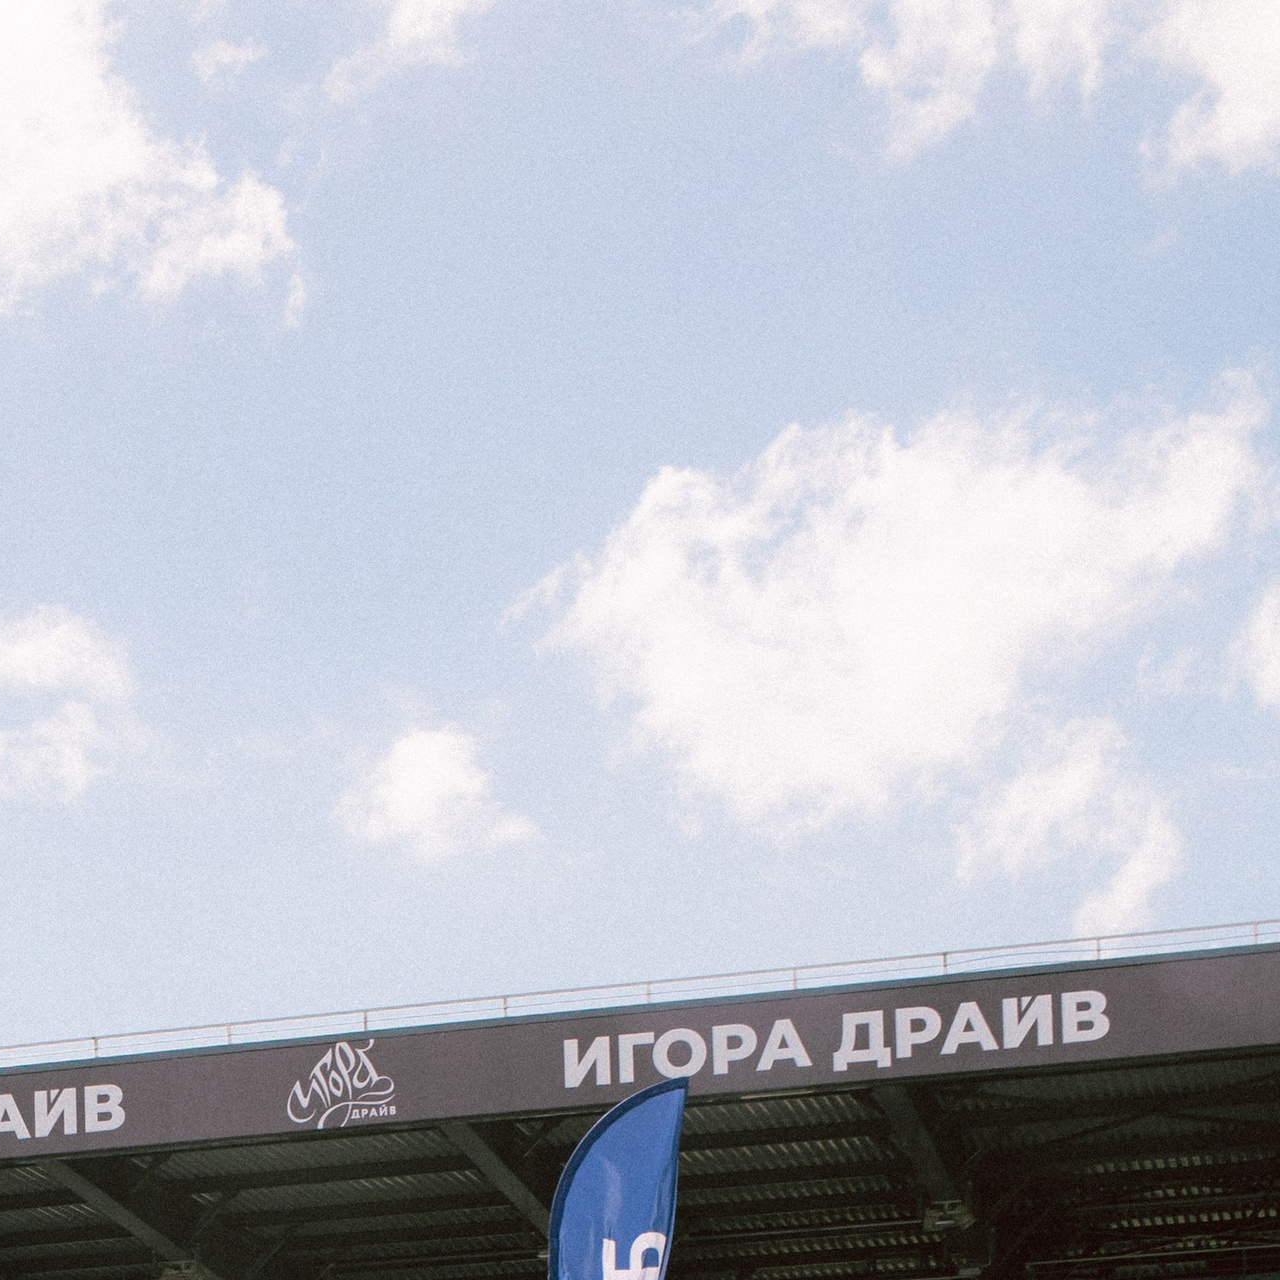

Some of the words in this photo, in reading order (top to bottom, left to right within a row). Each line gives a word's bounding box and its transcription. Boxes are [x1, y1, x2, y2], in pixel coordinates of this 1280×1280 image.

[563, 1018, 812, 1089] ИГОРА
[833, 989, 1111, 1072] ДРАЙВ
[350, 1104, 397, 1119] ДРАЙВ
